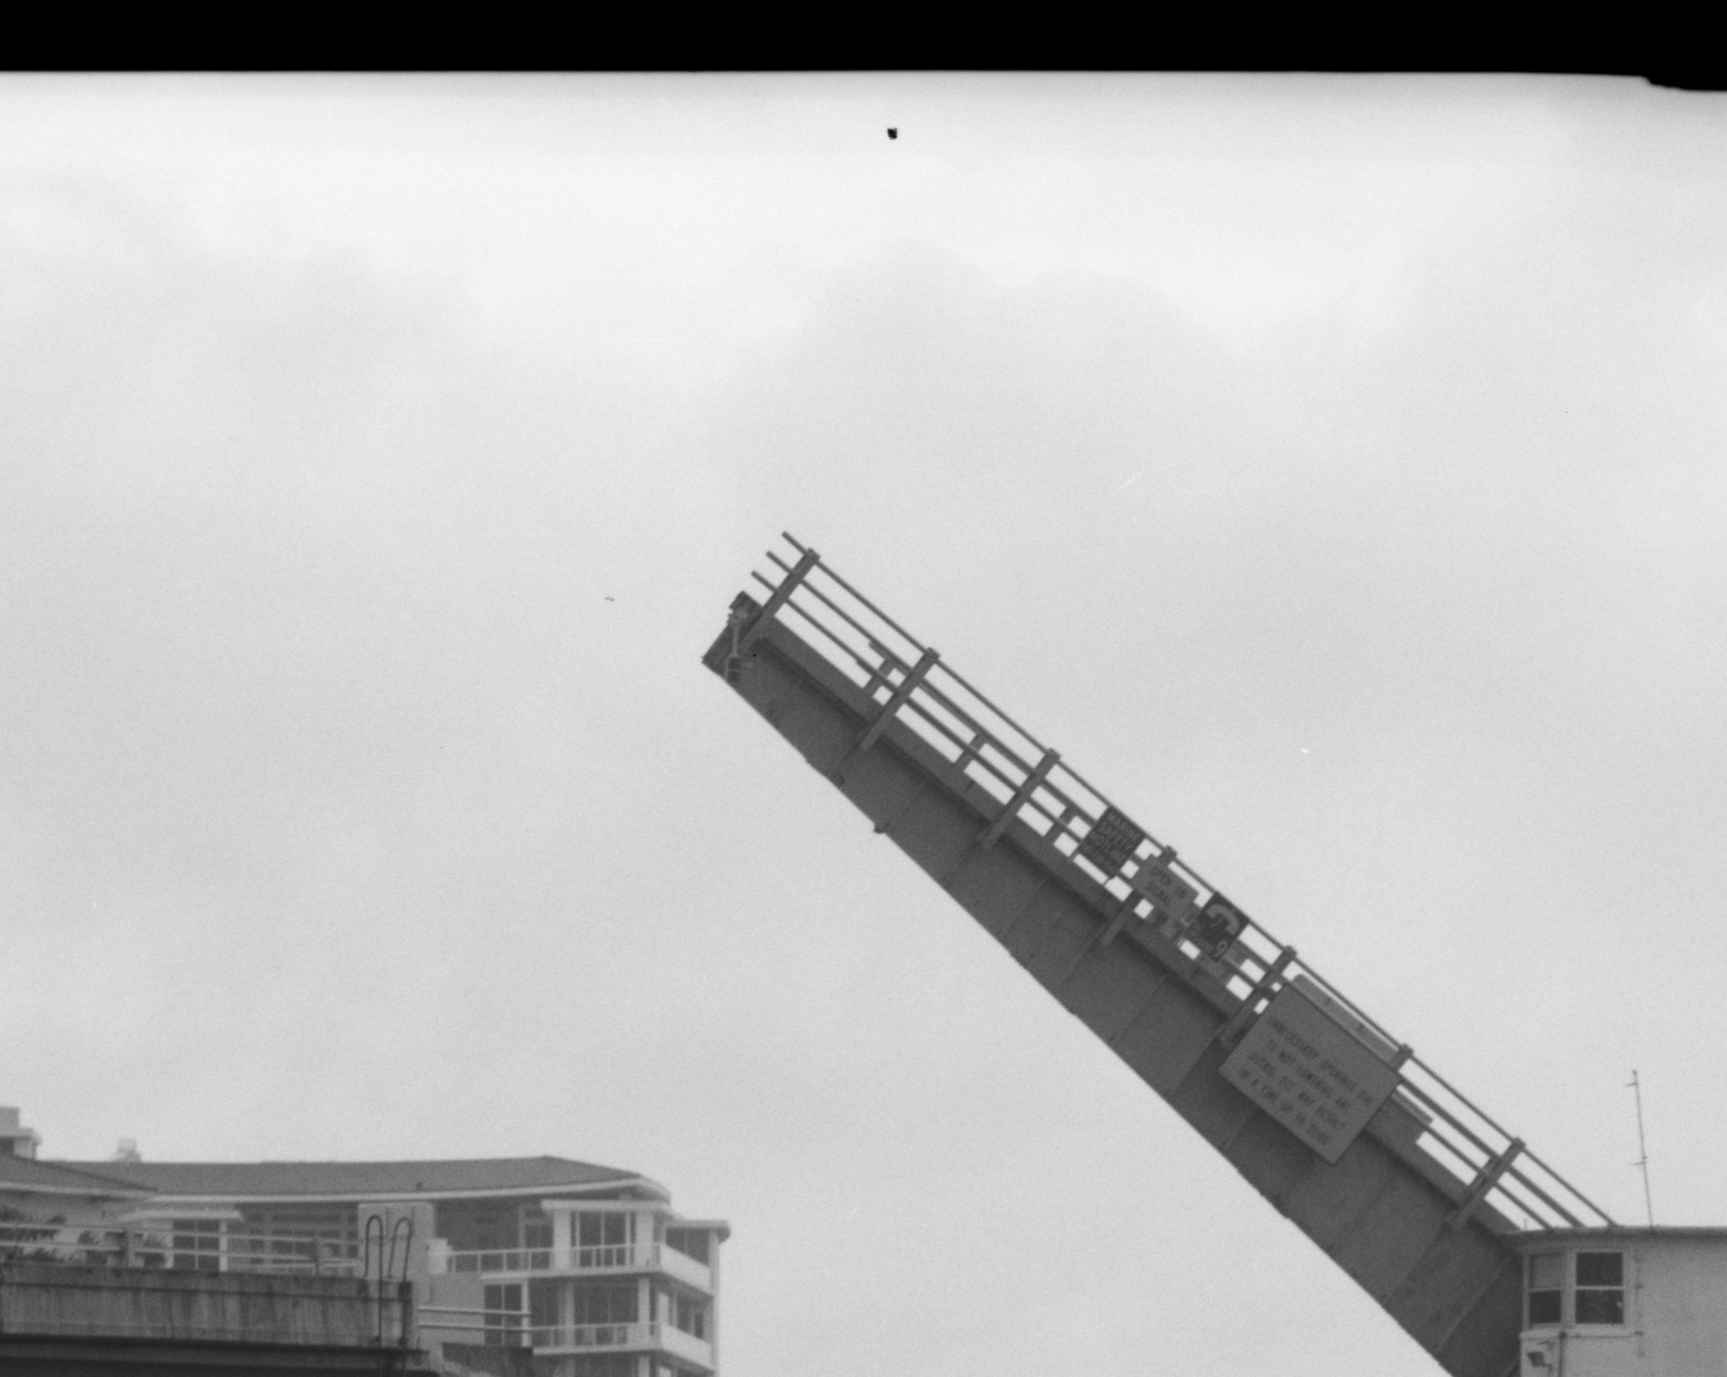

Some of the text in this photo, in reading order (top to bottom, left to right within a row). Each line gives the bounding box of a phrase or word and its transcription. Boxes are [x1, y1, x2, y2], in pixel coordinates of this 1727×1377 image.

[1095, 819, 1134, 854] SAFETY
[1104, 810, 1142, 843] MARINE
[1086, 829, 1128, 865] HOTLINE
[1148, 864, 1174, 887] OPEN
[1143, 879, 1175, 908] SIGNAL
[1263, 1014, 1321, 1062] UNNECESSARY
[1264, 1038, 1279, 1054] TO
[1276, 1048, 1297, 1068] NOT
[1294, 1063, 1336, 1098] LOWERING
[1296, 1090, 1316, 1108] MAY
[1314, 1103, 1347, 1133] RESULT
